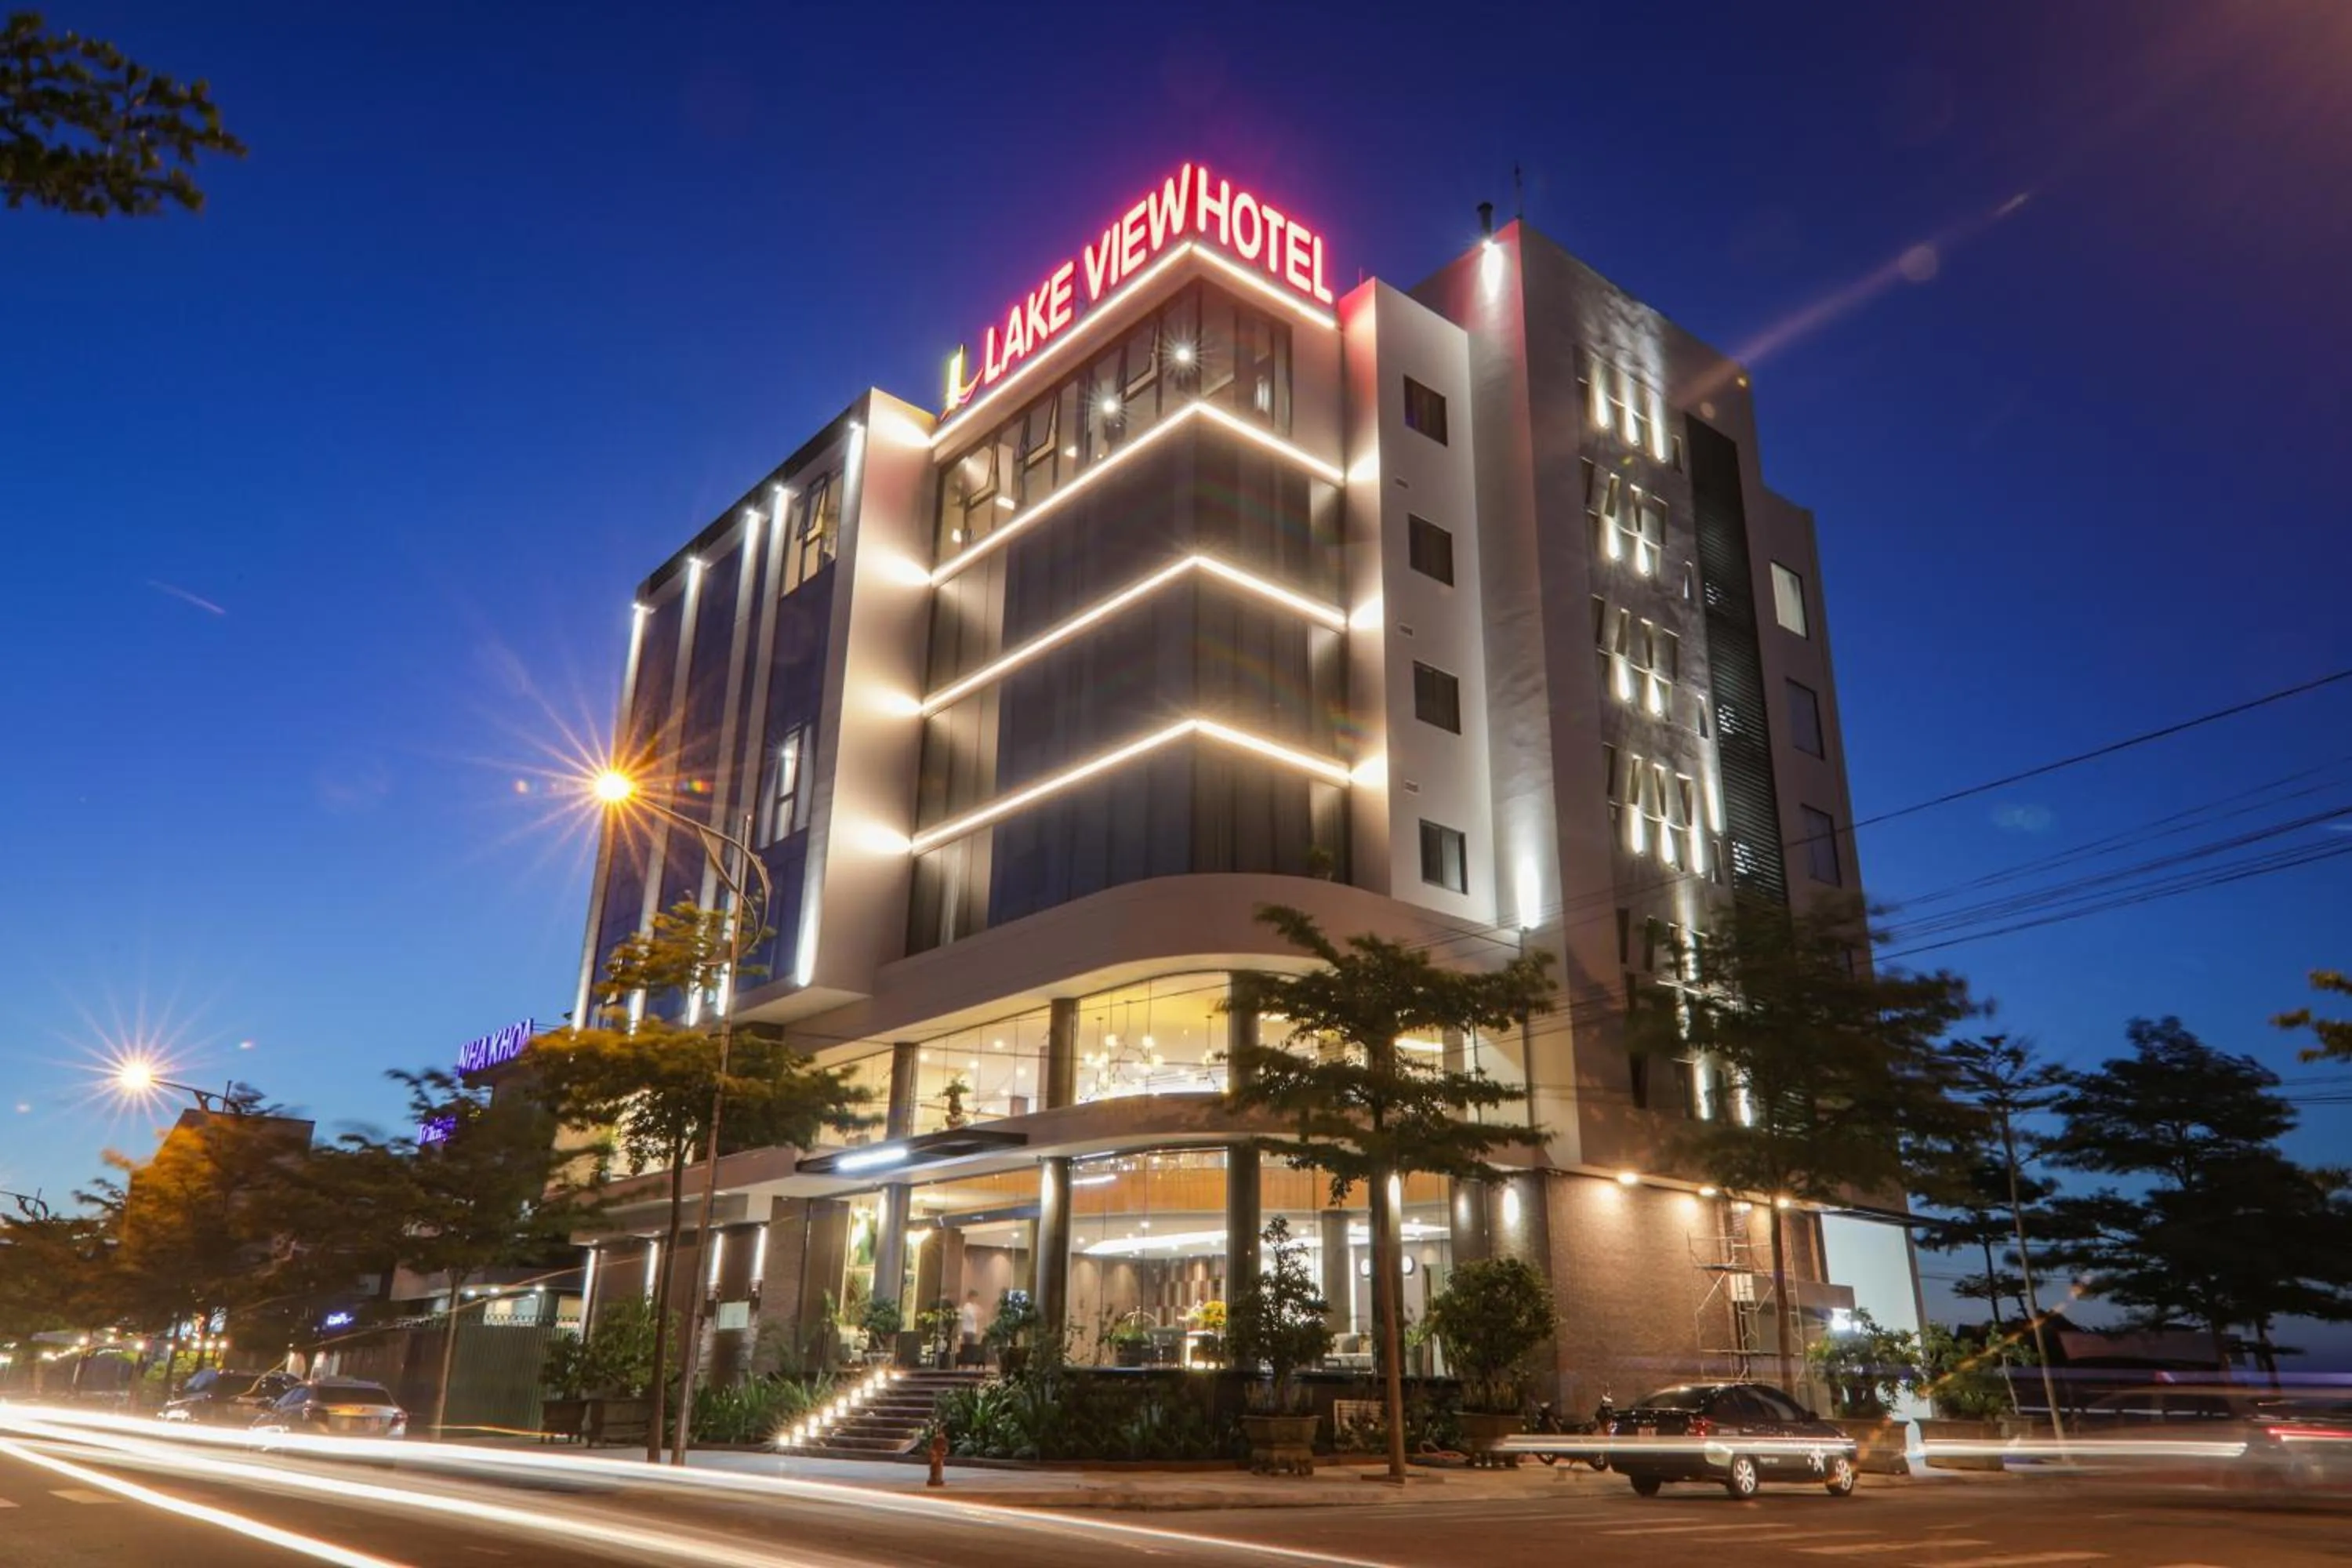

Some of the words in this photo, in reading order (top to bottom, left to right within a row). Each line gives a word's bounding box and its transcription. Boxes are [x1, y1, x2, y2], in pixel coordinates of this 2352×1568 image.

[984, 261, 1074, 384] LAKE
[1084, 162, 1191, 300] VIEW
[1197, 167, 1333, 304] HOTEL
[458, 1036, 486, 1070] NHA
